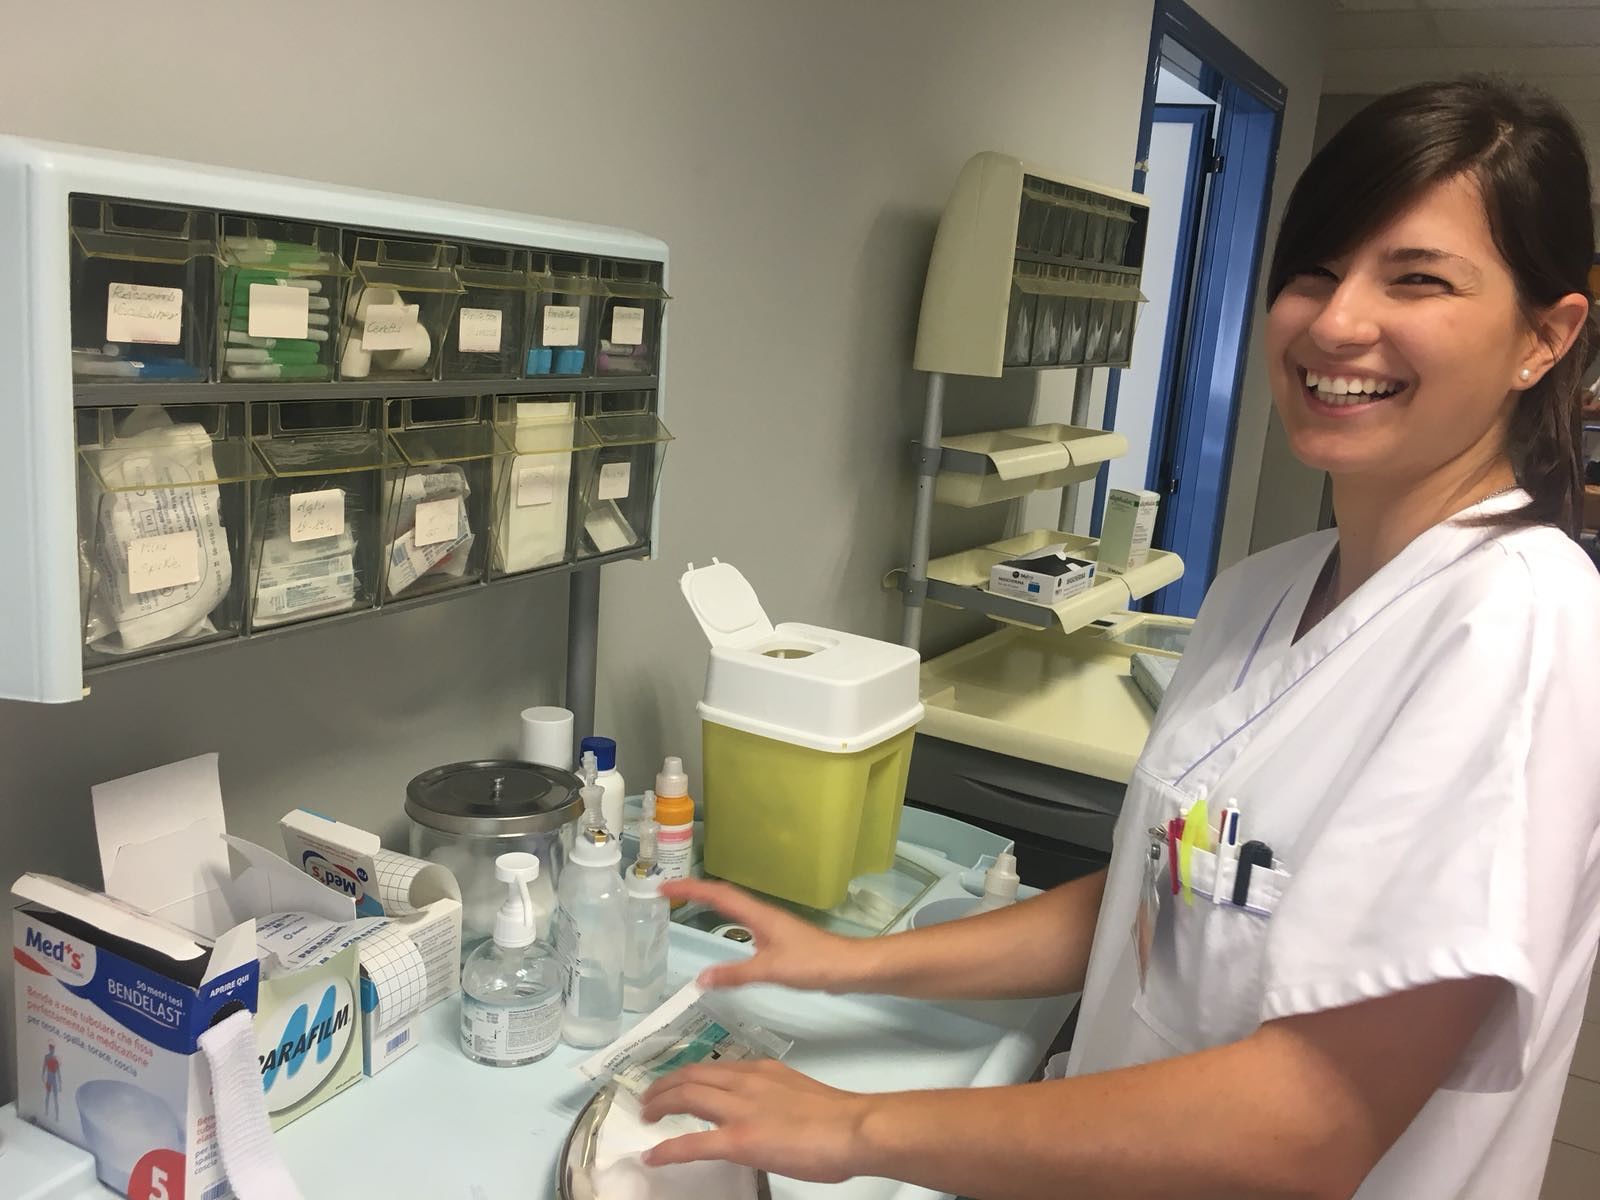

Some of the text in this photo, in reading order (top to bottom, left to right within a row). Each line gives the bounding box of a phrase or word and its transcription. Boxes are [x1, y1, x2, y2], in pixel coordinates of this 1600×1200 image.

[136, 980, 183, 1009] 50 metri tesi
[209, 973, 250, 998] APRIRE QUI
[107, 978, 183, 1027] BENDELAST
[80, 1011, 116, 1035] tubolare
[86, 1026, 96, 1040] la
[148, 1165, 170, 1200] 5
